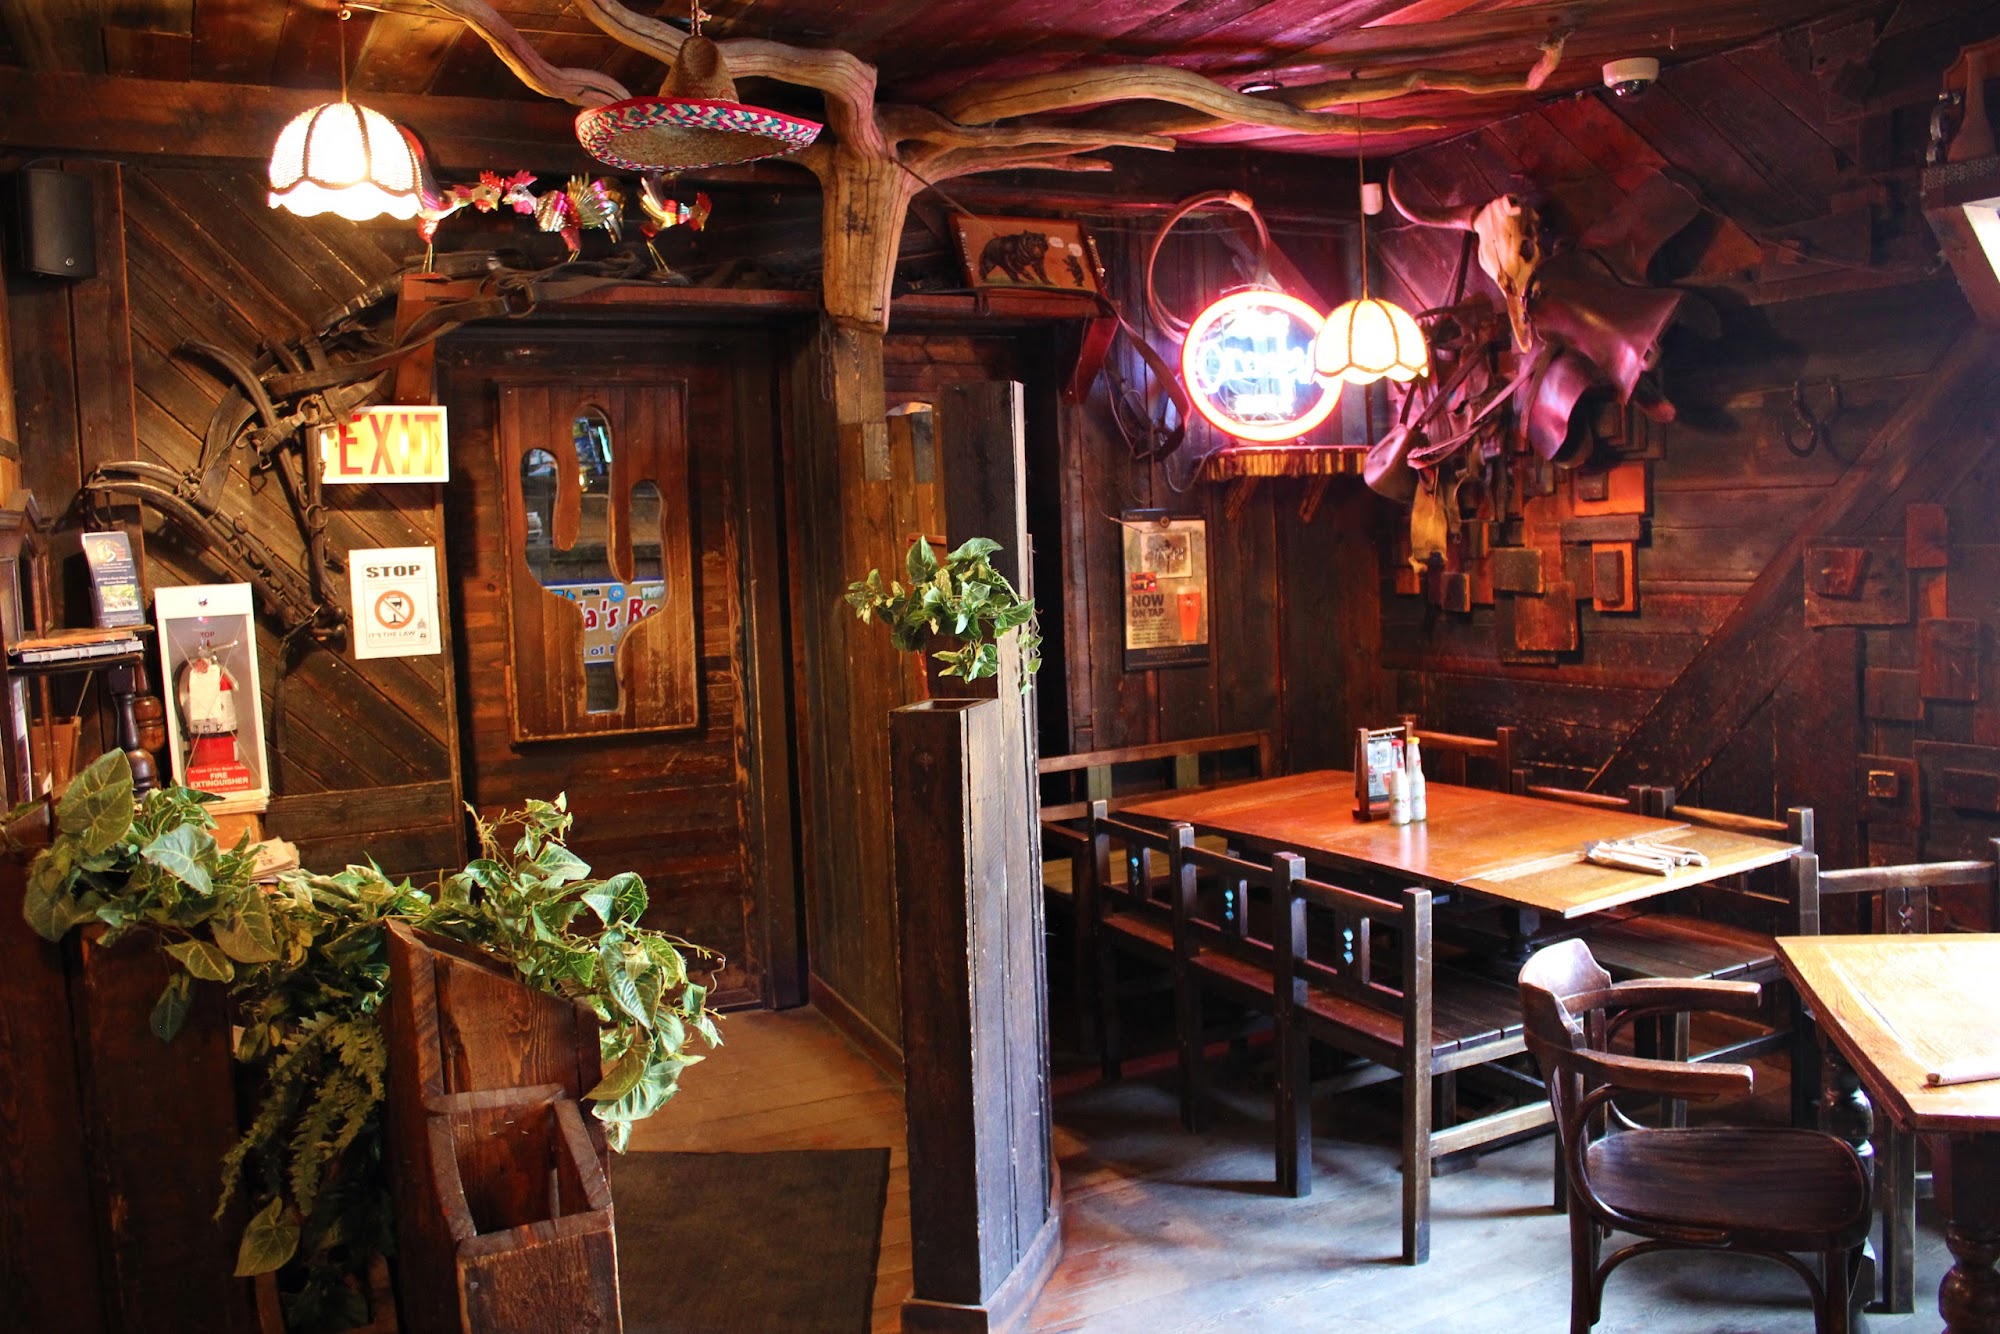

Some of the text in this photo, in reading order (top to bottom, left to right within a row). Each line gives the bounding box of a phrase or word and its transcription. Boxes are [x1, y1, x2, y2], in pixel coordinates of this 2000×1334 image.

[338, 414, 438, 475] EXIT
[366, 565, 421, 578] STOP
[1132, 594, 1164, 607] NOW
[579, 600, 619, 628] a's
[1132, 608, 1164, 618] ON TAP
[590, 646, 604, 656] of
[210, 772, 228, 780] FIRE
[190, 777, 248, 789] EXTINGUISHER
